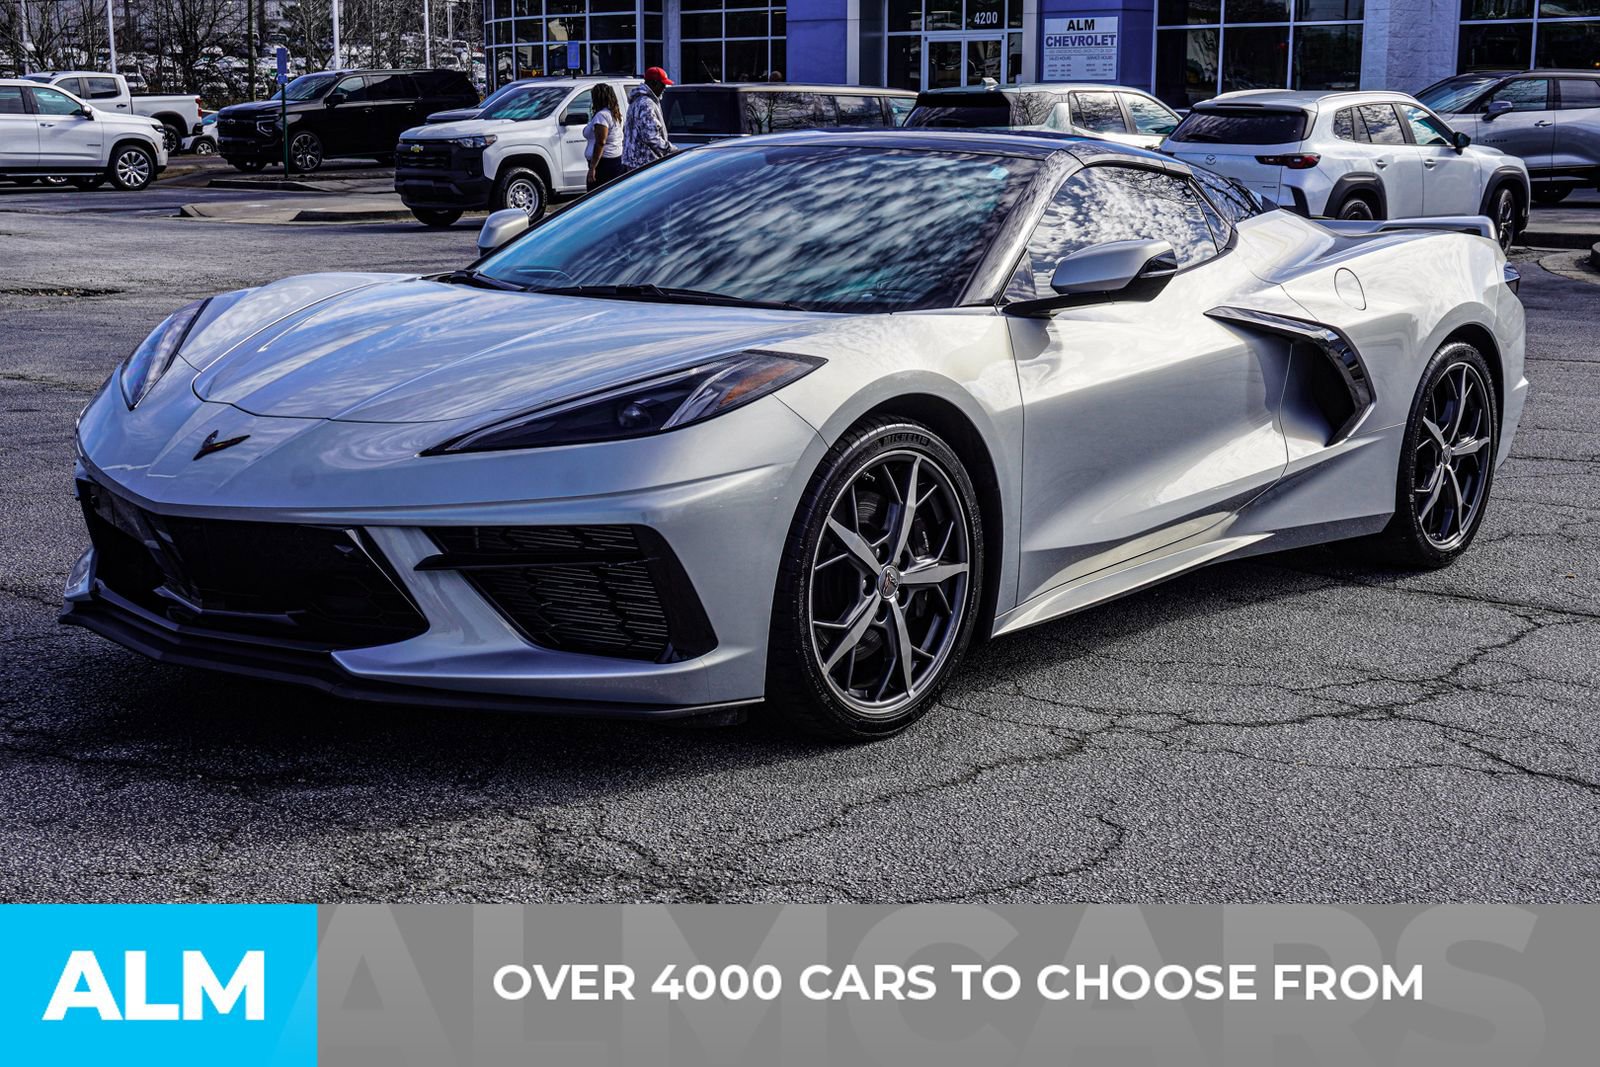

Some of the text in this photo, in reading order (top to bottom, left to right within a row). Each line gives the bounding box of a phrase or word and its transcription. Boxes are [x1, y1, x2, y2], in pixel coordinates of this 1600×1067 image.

[974, 11, 998, 24] 4200
[1067, 19, 1094, 31] ALM
[1046, 35, 1115, 47] CHEVROLET
